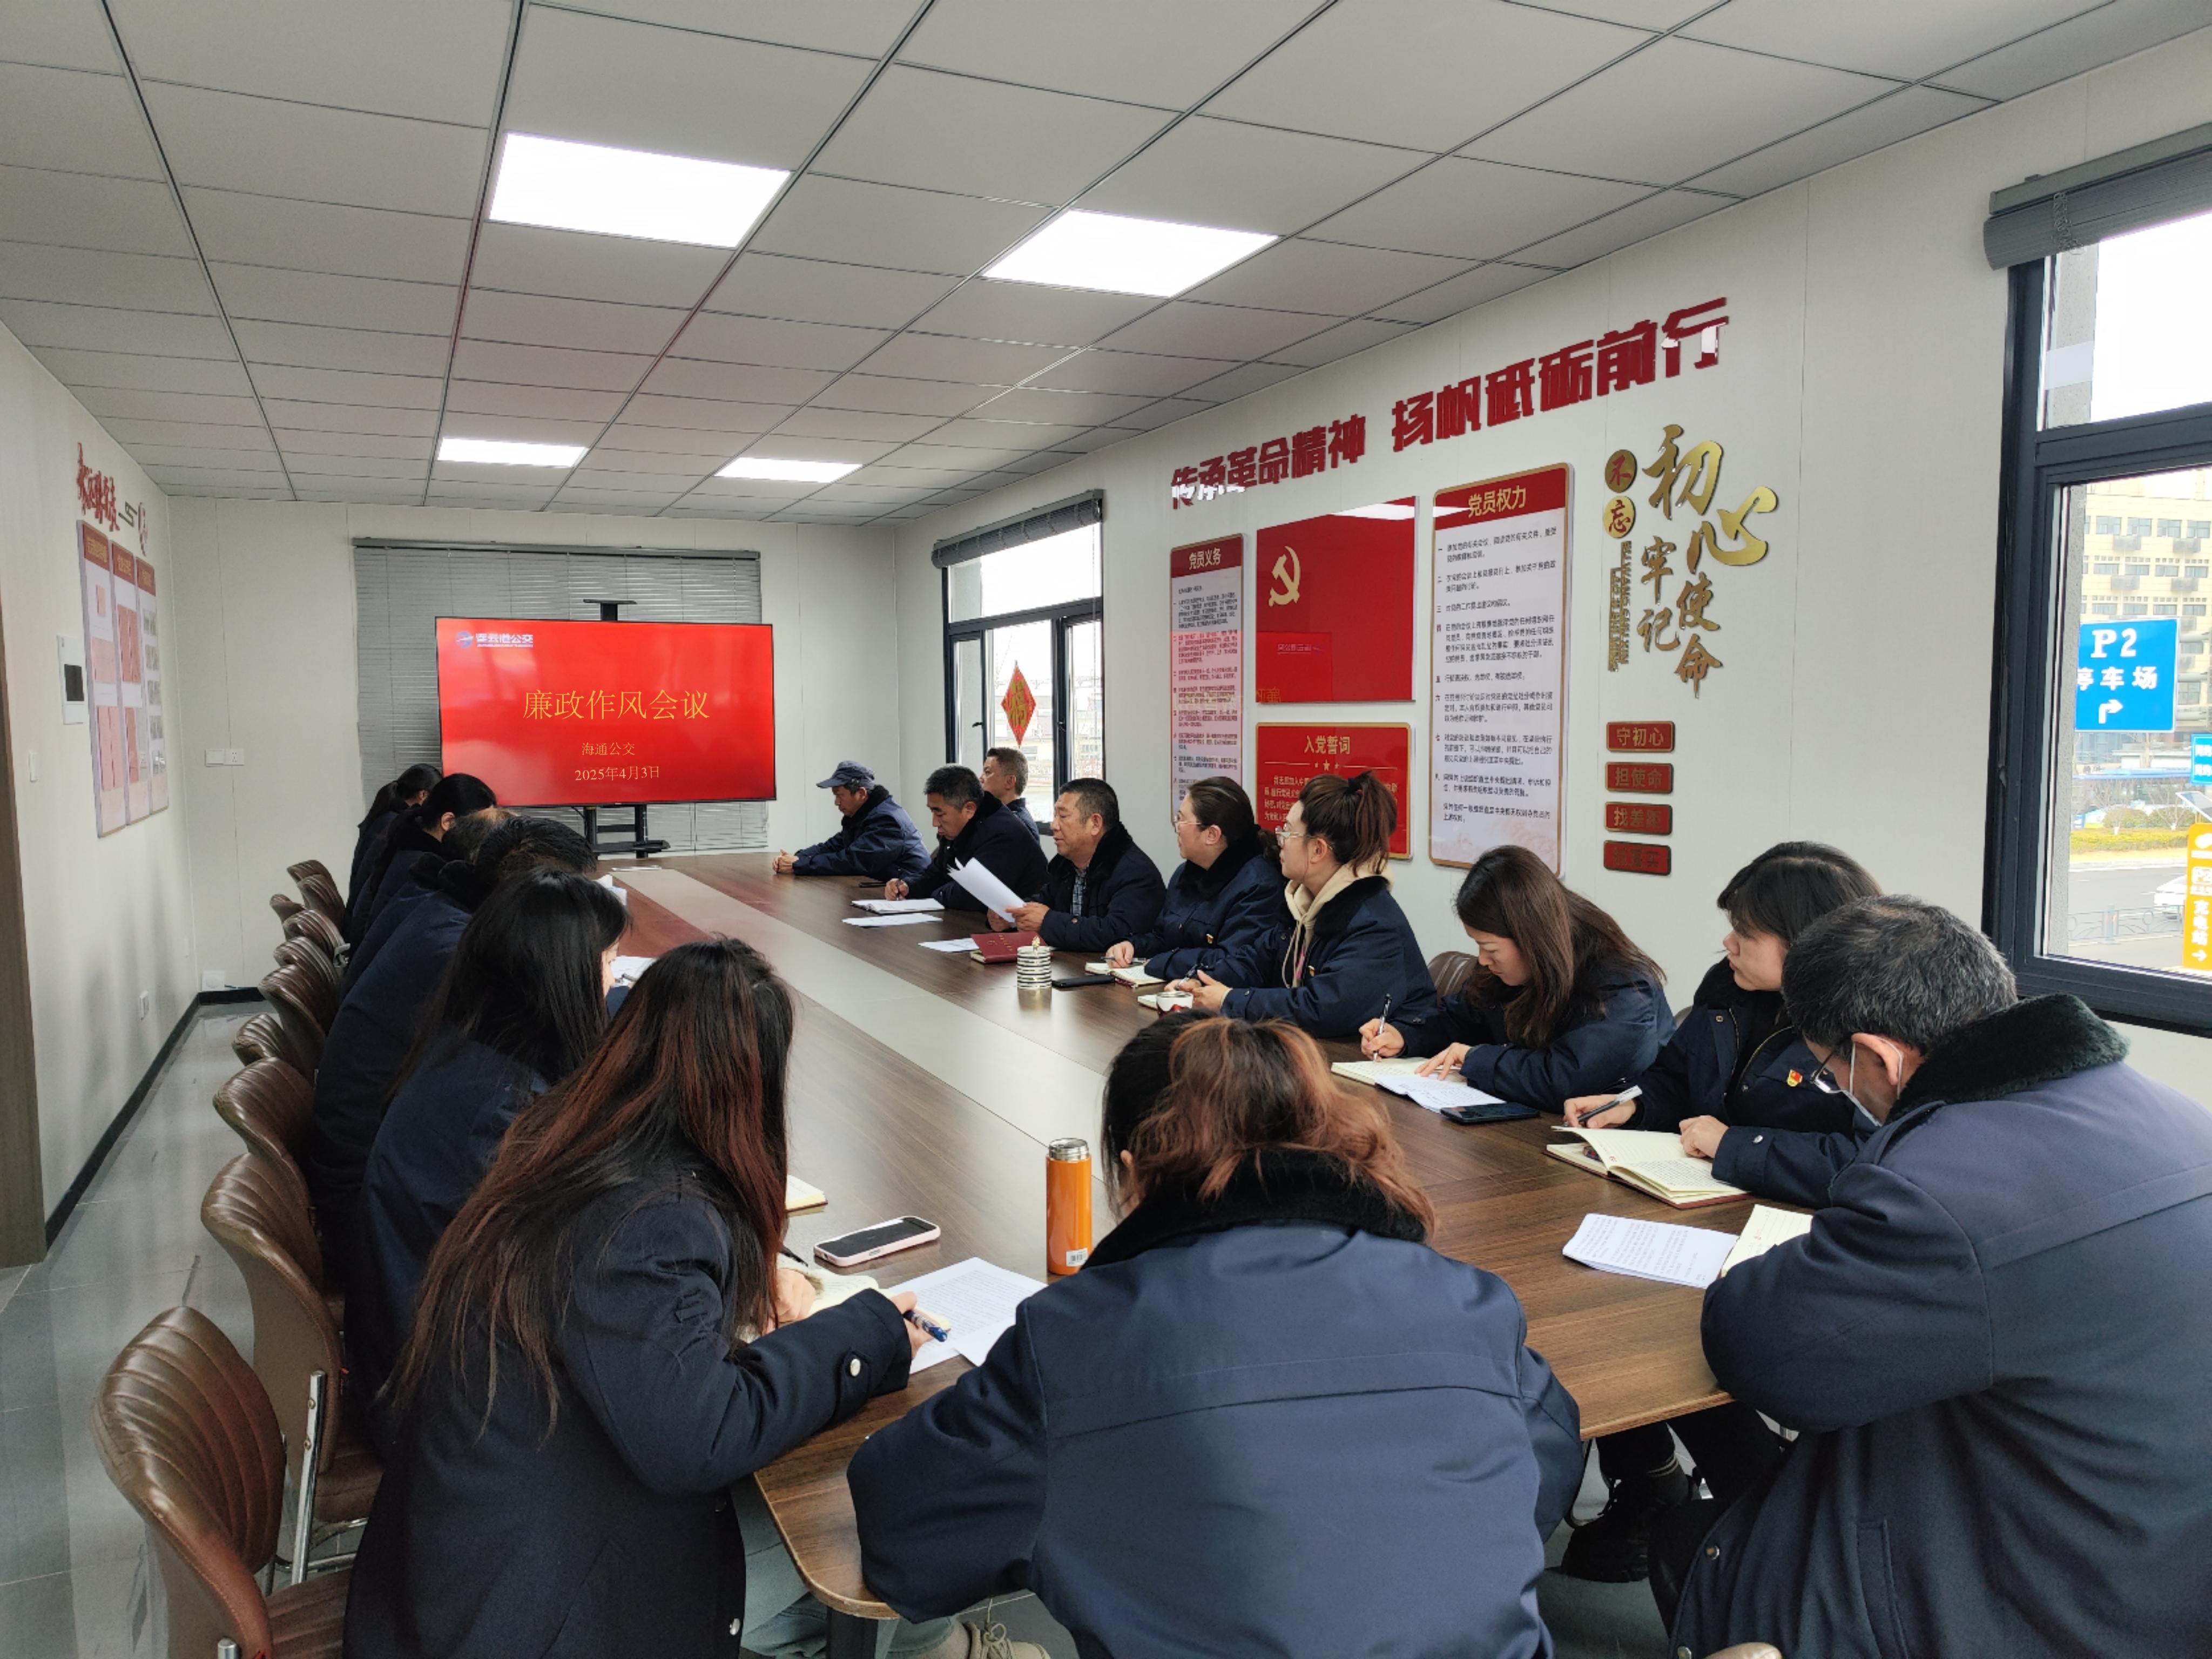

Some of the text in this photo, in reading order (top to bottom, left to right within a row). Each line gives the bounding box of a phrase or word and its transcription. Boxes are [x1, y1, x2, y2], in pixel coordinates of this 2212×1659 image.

[1392, 297, 1729, 453] 扬帆砥砺前行
[1468, 487, 1527, 518] 党员权力
[1642, 424, 1778, 574] 初心
[1189, 548, 1221, 570] 党员义务
[2090, 628, 2137, 658] P2
[523, 689, 710, 720] 廉政作风会议
[1304, 735, 1351, 754] 入党誓词
[1616, 727, 1664, 746] 守初心
[582, 742, 636, 756] 海通公交
[575, 766, 659, 781] 2025年4月3日
[1615, 768, 1663, 787] 担使命
